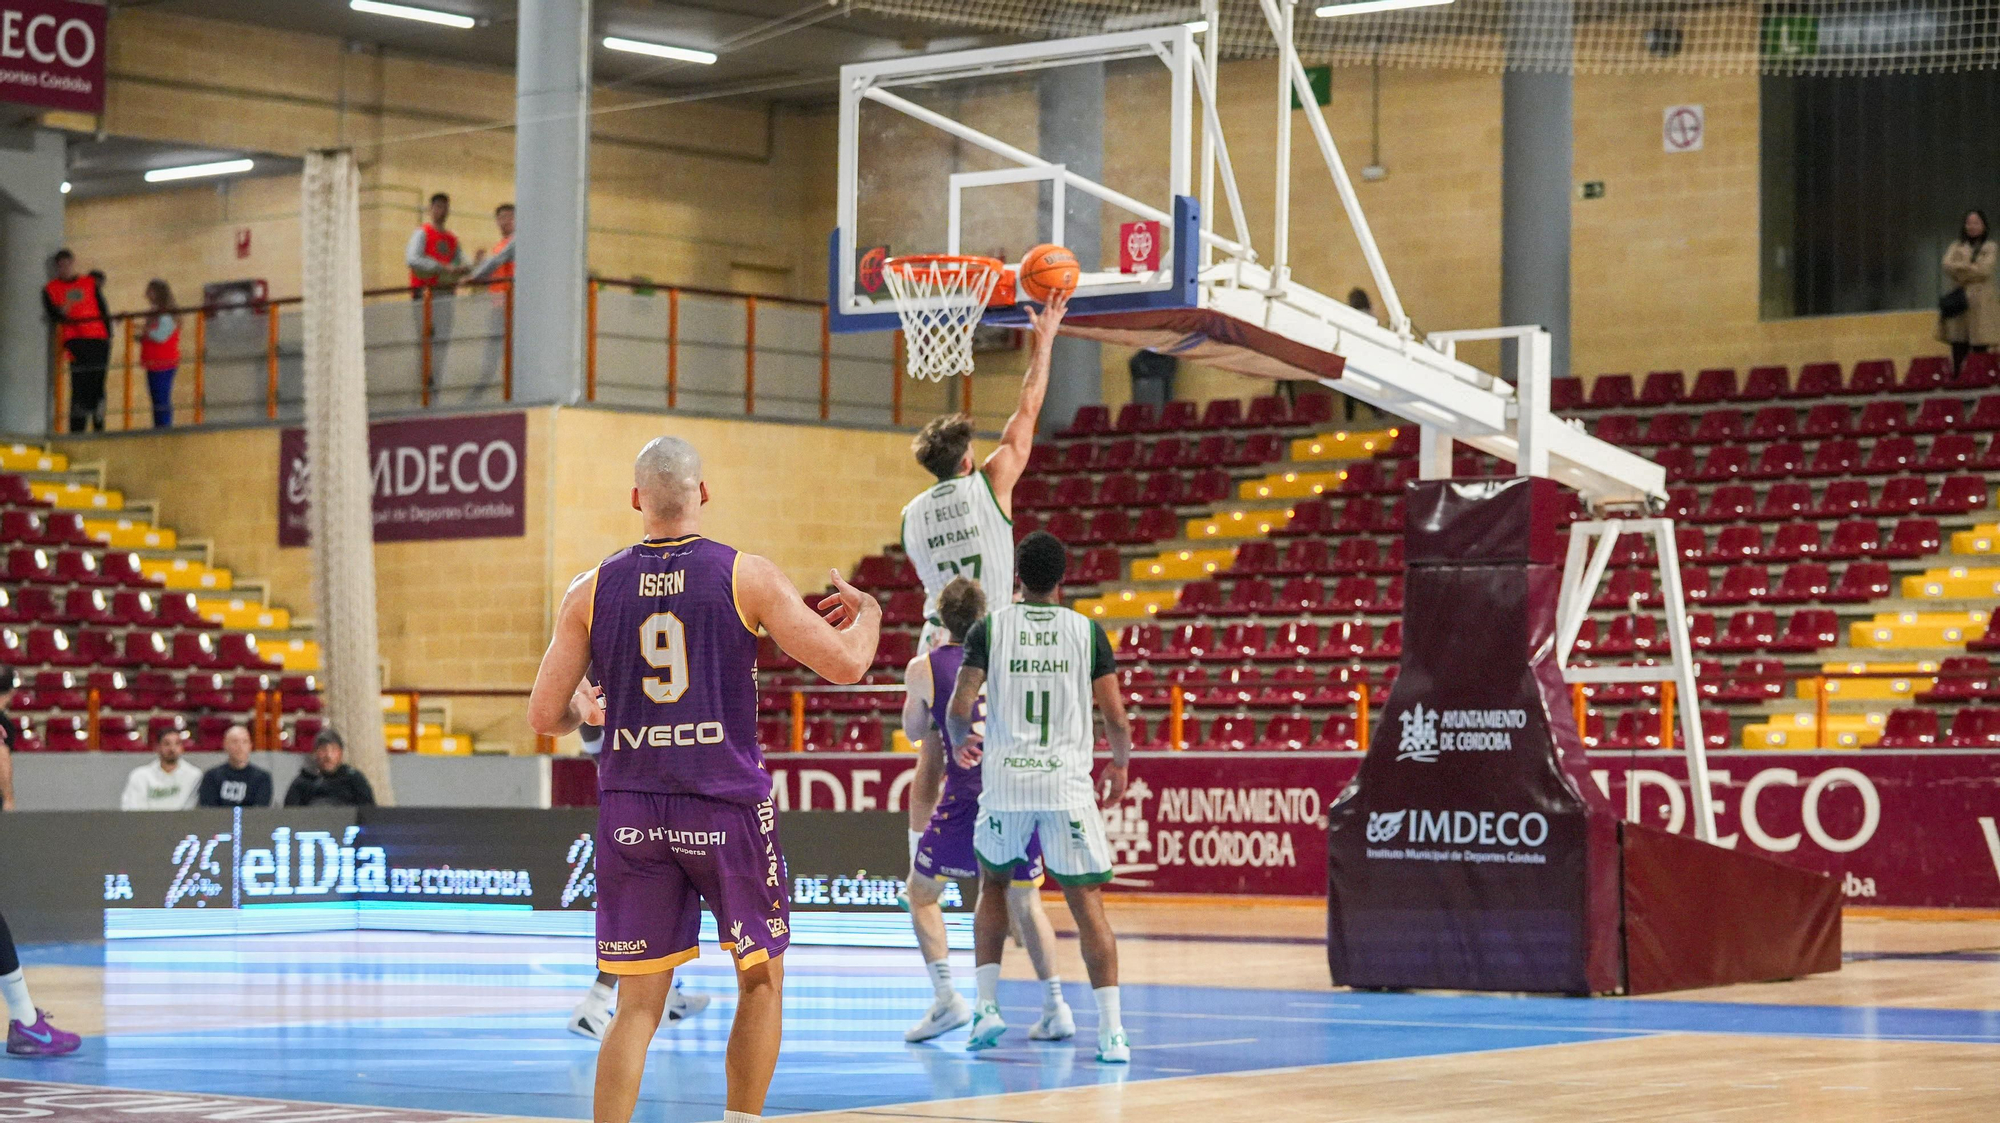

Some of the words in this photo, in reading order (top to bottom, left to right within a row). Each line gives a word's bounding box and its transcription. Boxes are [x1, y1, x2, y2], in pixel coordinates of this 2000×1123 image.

[2, 9, 96, 68] ECO
[372, 440, 518, 497] MDECO
[935, 501, 971, 523] BELLO
[946, 525, 980, 545] RAHI
[638, 569, 685, 597] ISERN
[1019, 631, 1059, 647] BLACK
[638, 610, 690, 704] 9
[1031, 660, 1069, 673] RAHI
[1025, 690, 1050, 747] 4
[1440, 709, 1527, 729] AYUNTAMIENTO
[612, 721, 725, 751] IVECO
[1440, 732, 1455, 751] DE
[1003, 757, 1043, 769] PIEDRA
[1157, 787, 1321, 824] AYUNTAMIENTO
[1591, 767, 1881, 853] DECO
[1408, 809, 1549, 847] IMDECO
[1157, 830, 1185, 866] DE
[1188, 825, 1296, 867] CÓRDOBA
[1366, 848, 1403, 860] Instituto
[1405, 849, 1449, 862] Municipal
[1464, 850, 1505, 864] Deportes
[598, 939, 648, 951] SYNERGIA
